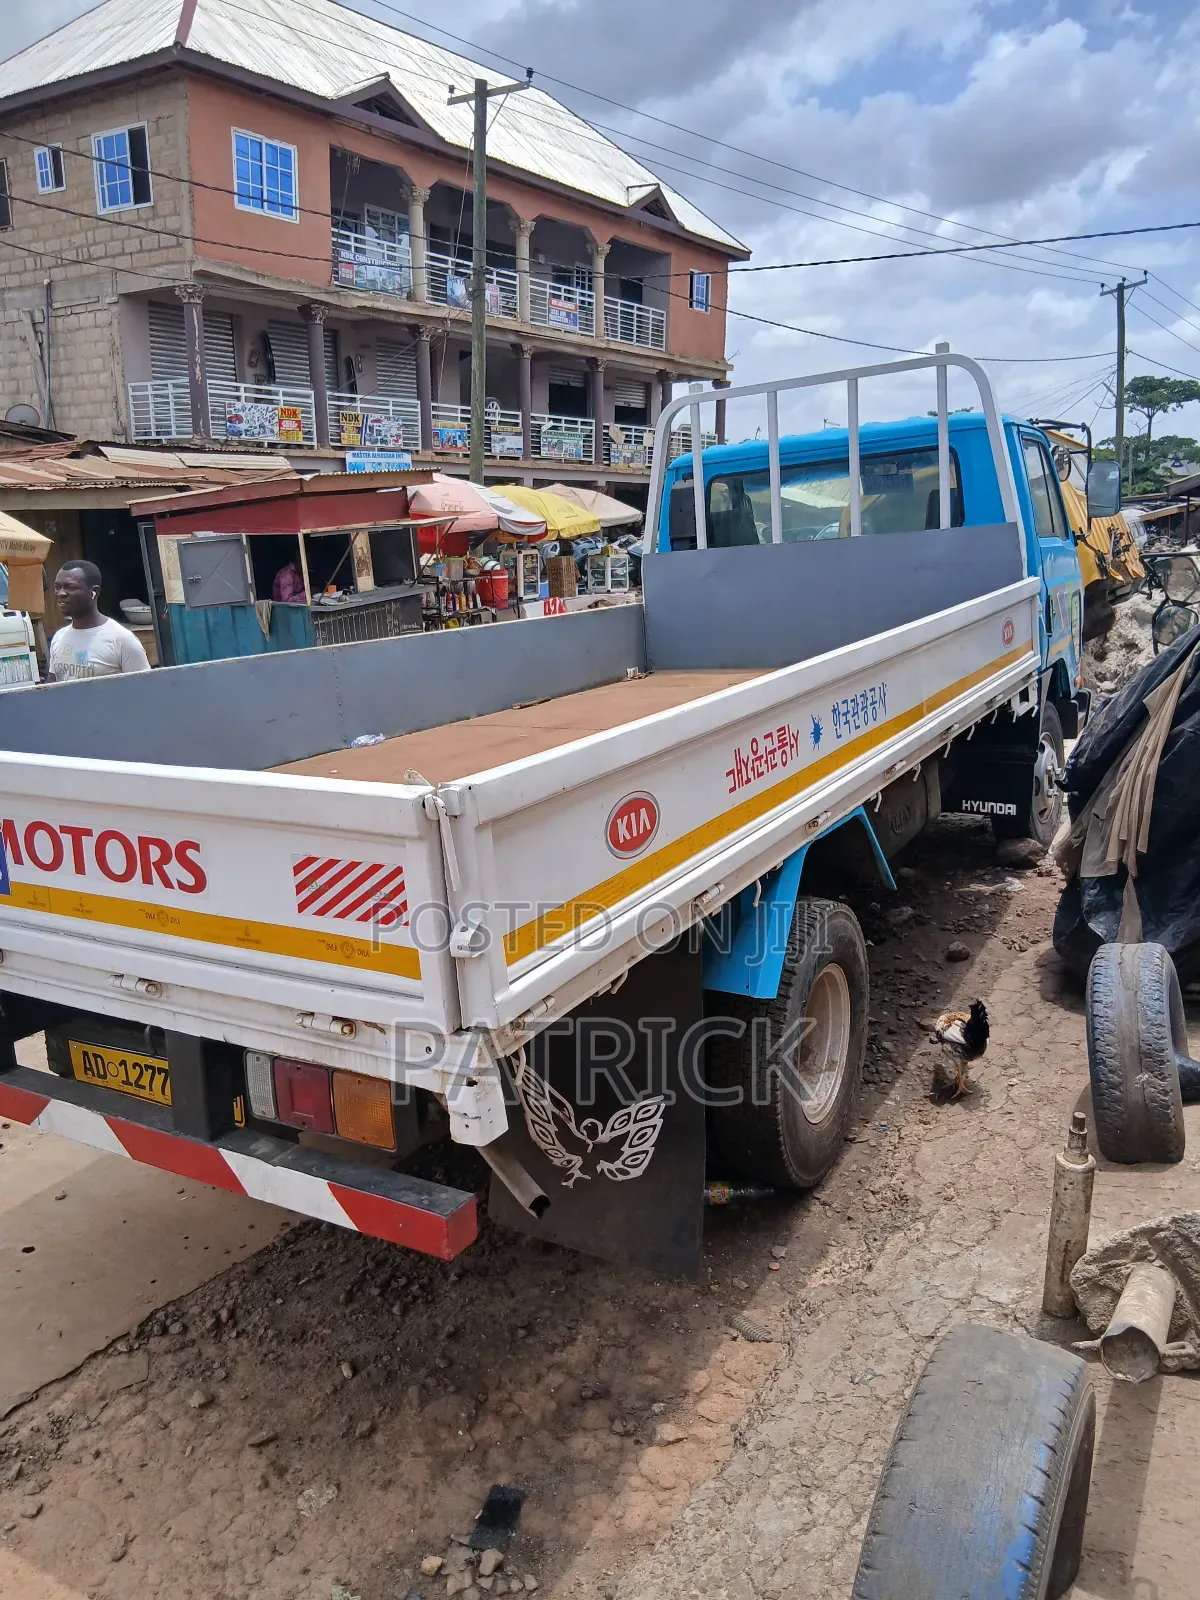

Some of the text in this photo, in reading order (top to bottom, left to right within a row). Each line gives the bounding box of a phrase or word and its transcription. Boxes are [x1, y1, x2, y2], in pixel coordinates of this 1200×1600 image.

[280, 408, 297, 418] NDK
[341, 413, 360, 422] NDK
[832, 682, 888, 740] 한국관광공사
[962, 799, 1017, 816] HYUNDAI
[616, 808, 652, 845] KIA
[82, 1050, 108, 1080] AD
